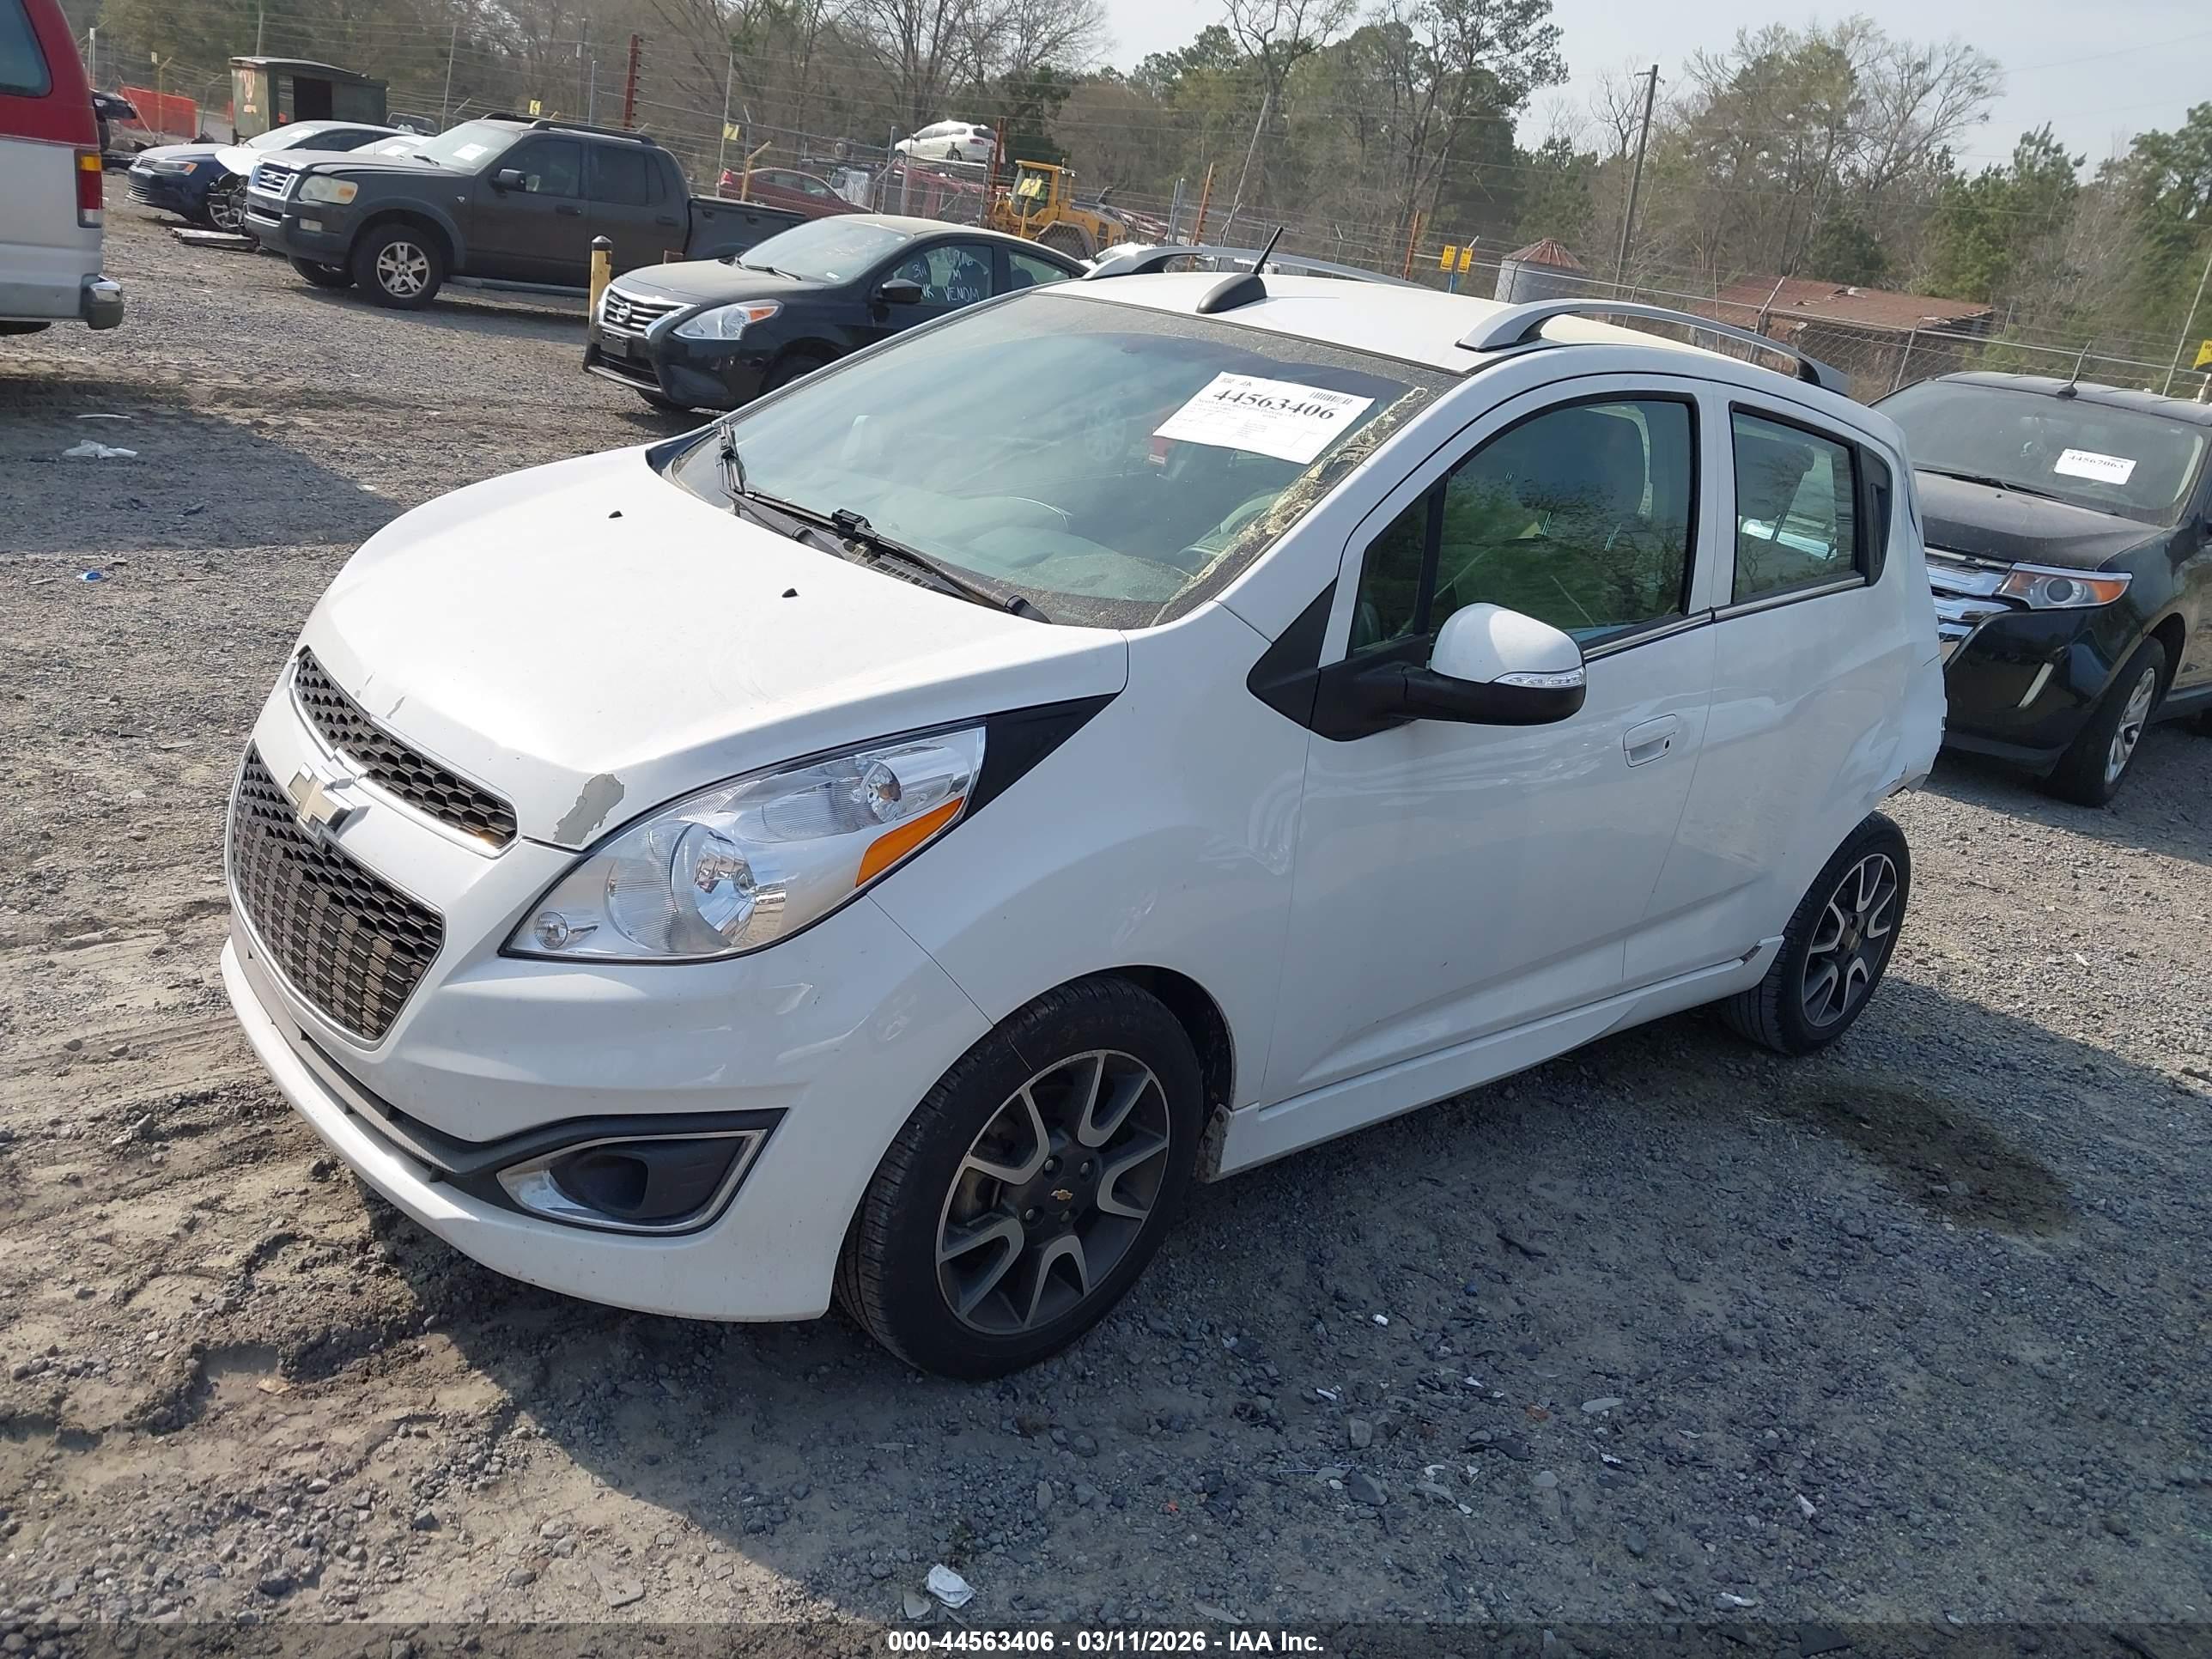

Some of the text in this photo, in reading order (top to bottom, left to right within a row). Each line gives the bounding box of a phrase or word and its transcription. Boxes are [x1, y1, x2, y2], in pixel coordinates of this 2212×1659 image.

[727, 123, 737, 138] 7
[1023, 179, 1037, 195] 8
[942, 285, 980, 302] VENOM
[1212, 389, 1340, 420] 44563406
